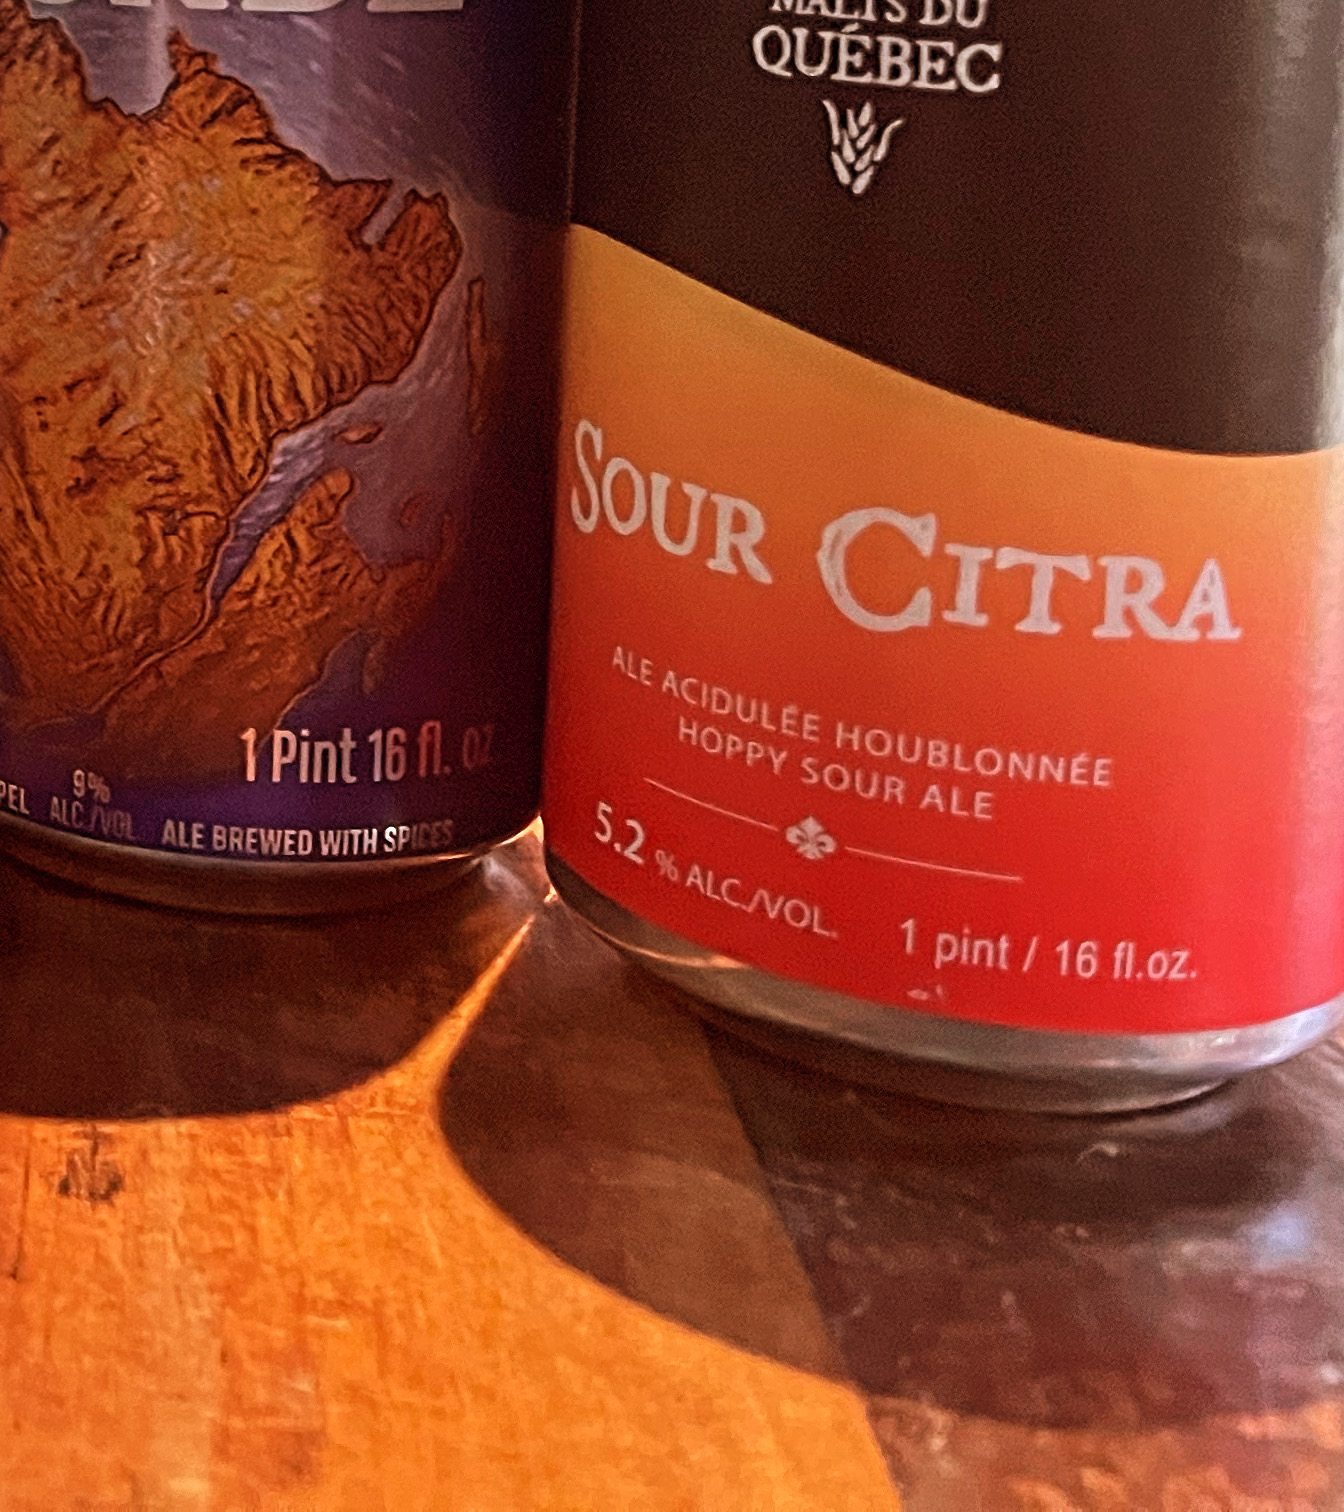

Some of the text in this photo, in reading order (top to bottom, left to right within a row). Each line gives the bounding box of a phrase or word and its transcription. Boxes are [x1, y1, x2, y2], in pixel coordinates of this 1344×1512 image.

[752, 19, 1003, 93] QUÉBEC
[571, 418, 1242, 643] SOUR CITRA
[240, 727, 257, 783] 1
[272, 728, 357, 784] Pint
[367, 727, 408, 783] 16
[417, 720, 452, 777] fl.
[612, 645, 1112, 788] ALE ACIDULÉE HOUBLONNÉE
[72, 769, 111, 804] 9%
[678, 717, 994, 820] HOPPY SOUR ALE
[161, 819, 454, 857] ALE BREWED WITH SPICES
[594, 800, 645, 865] 5.2
[655, 849, 679, 882] %
[900, 918, 915, 955] 1
[934, 926, 1009, 970] pint
[1022, 936, 1040, 973] /
[1056, 940, 1099, 979] 16
